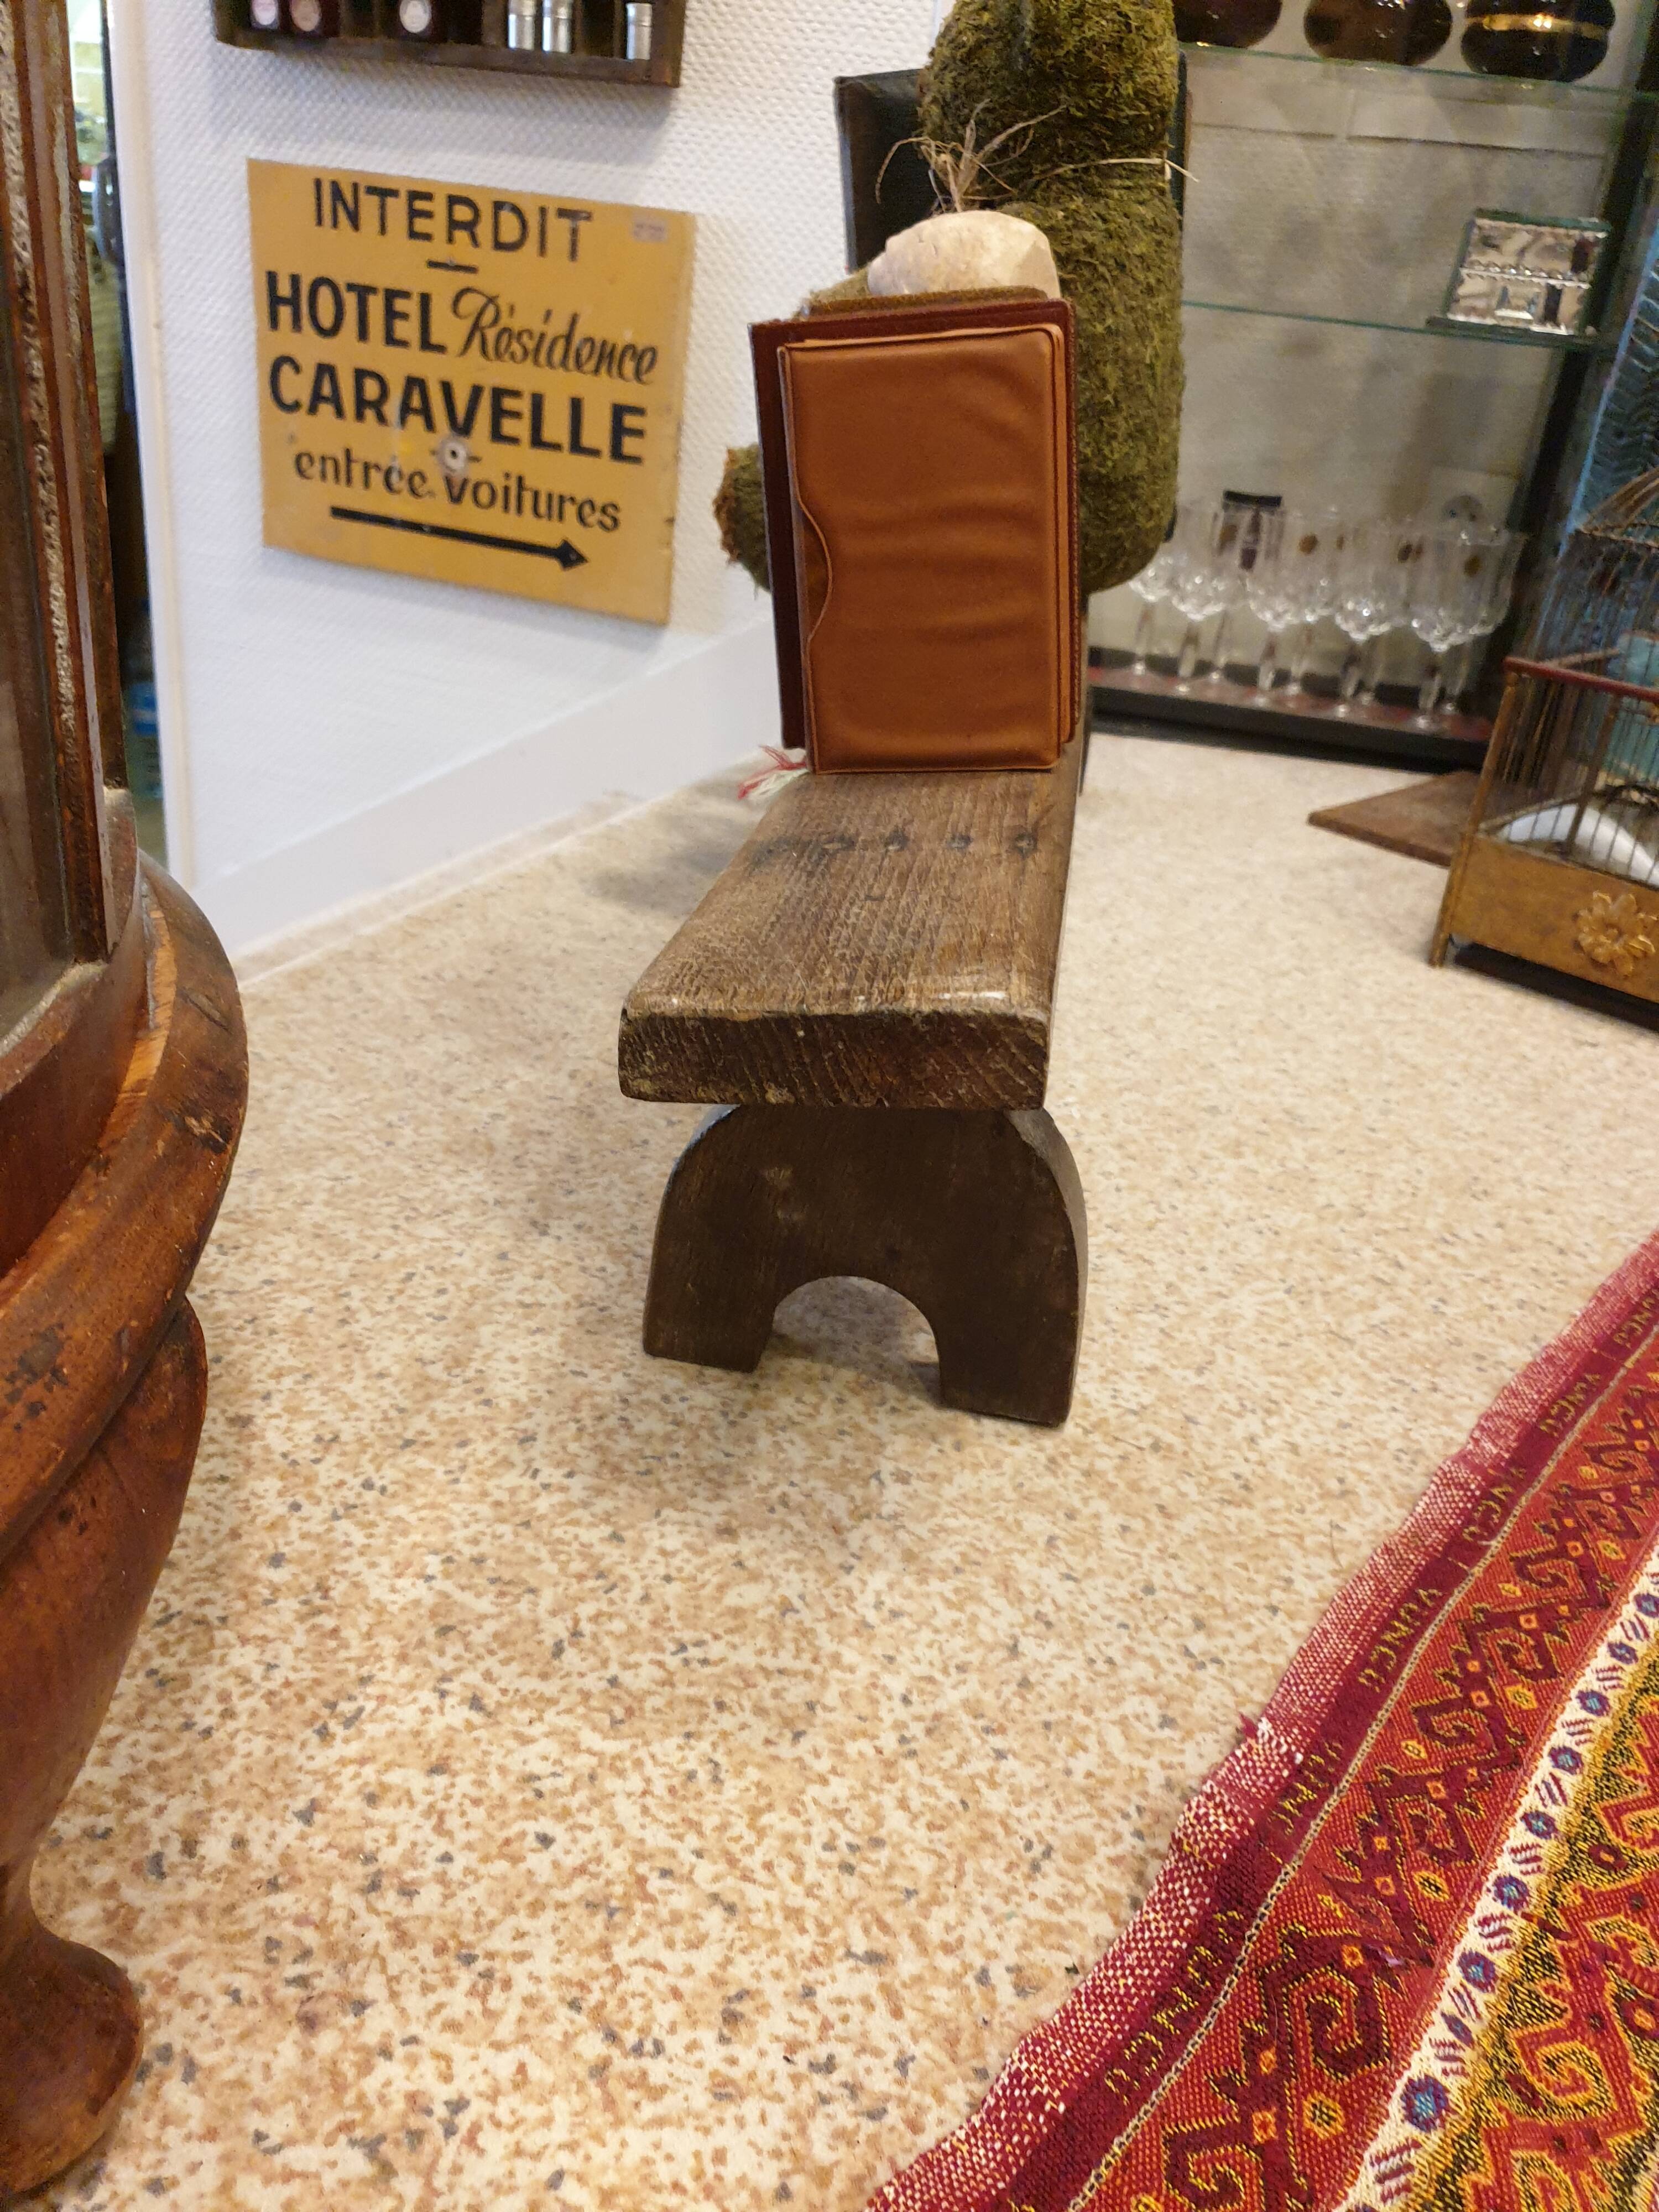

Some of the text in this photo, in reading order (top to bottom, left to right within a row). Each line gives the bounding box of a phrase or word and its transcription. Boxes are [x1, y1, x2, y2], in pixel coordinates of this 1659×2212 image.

[313, 178, 592, 262] INTERDIT
[266, 270, 659, 386] HOTEL Résidence
[269, 355, 646, 465] CARAVELLE
[443, 472, 621, 531] voitures
